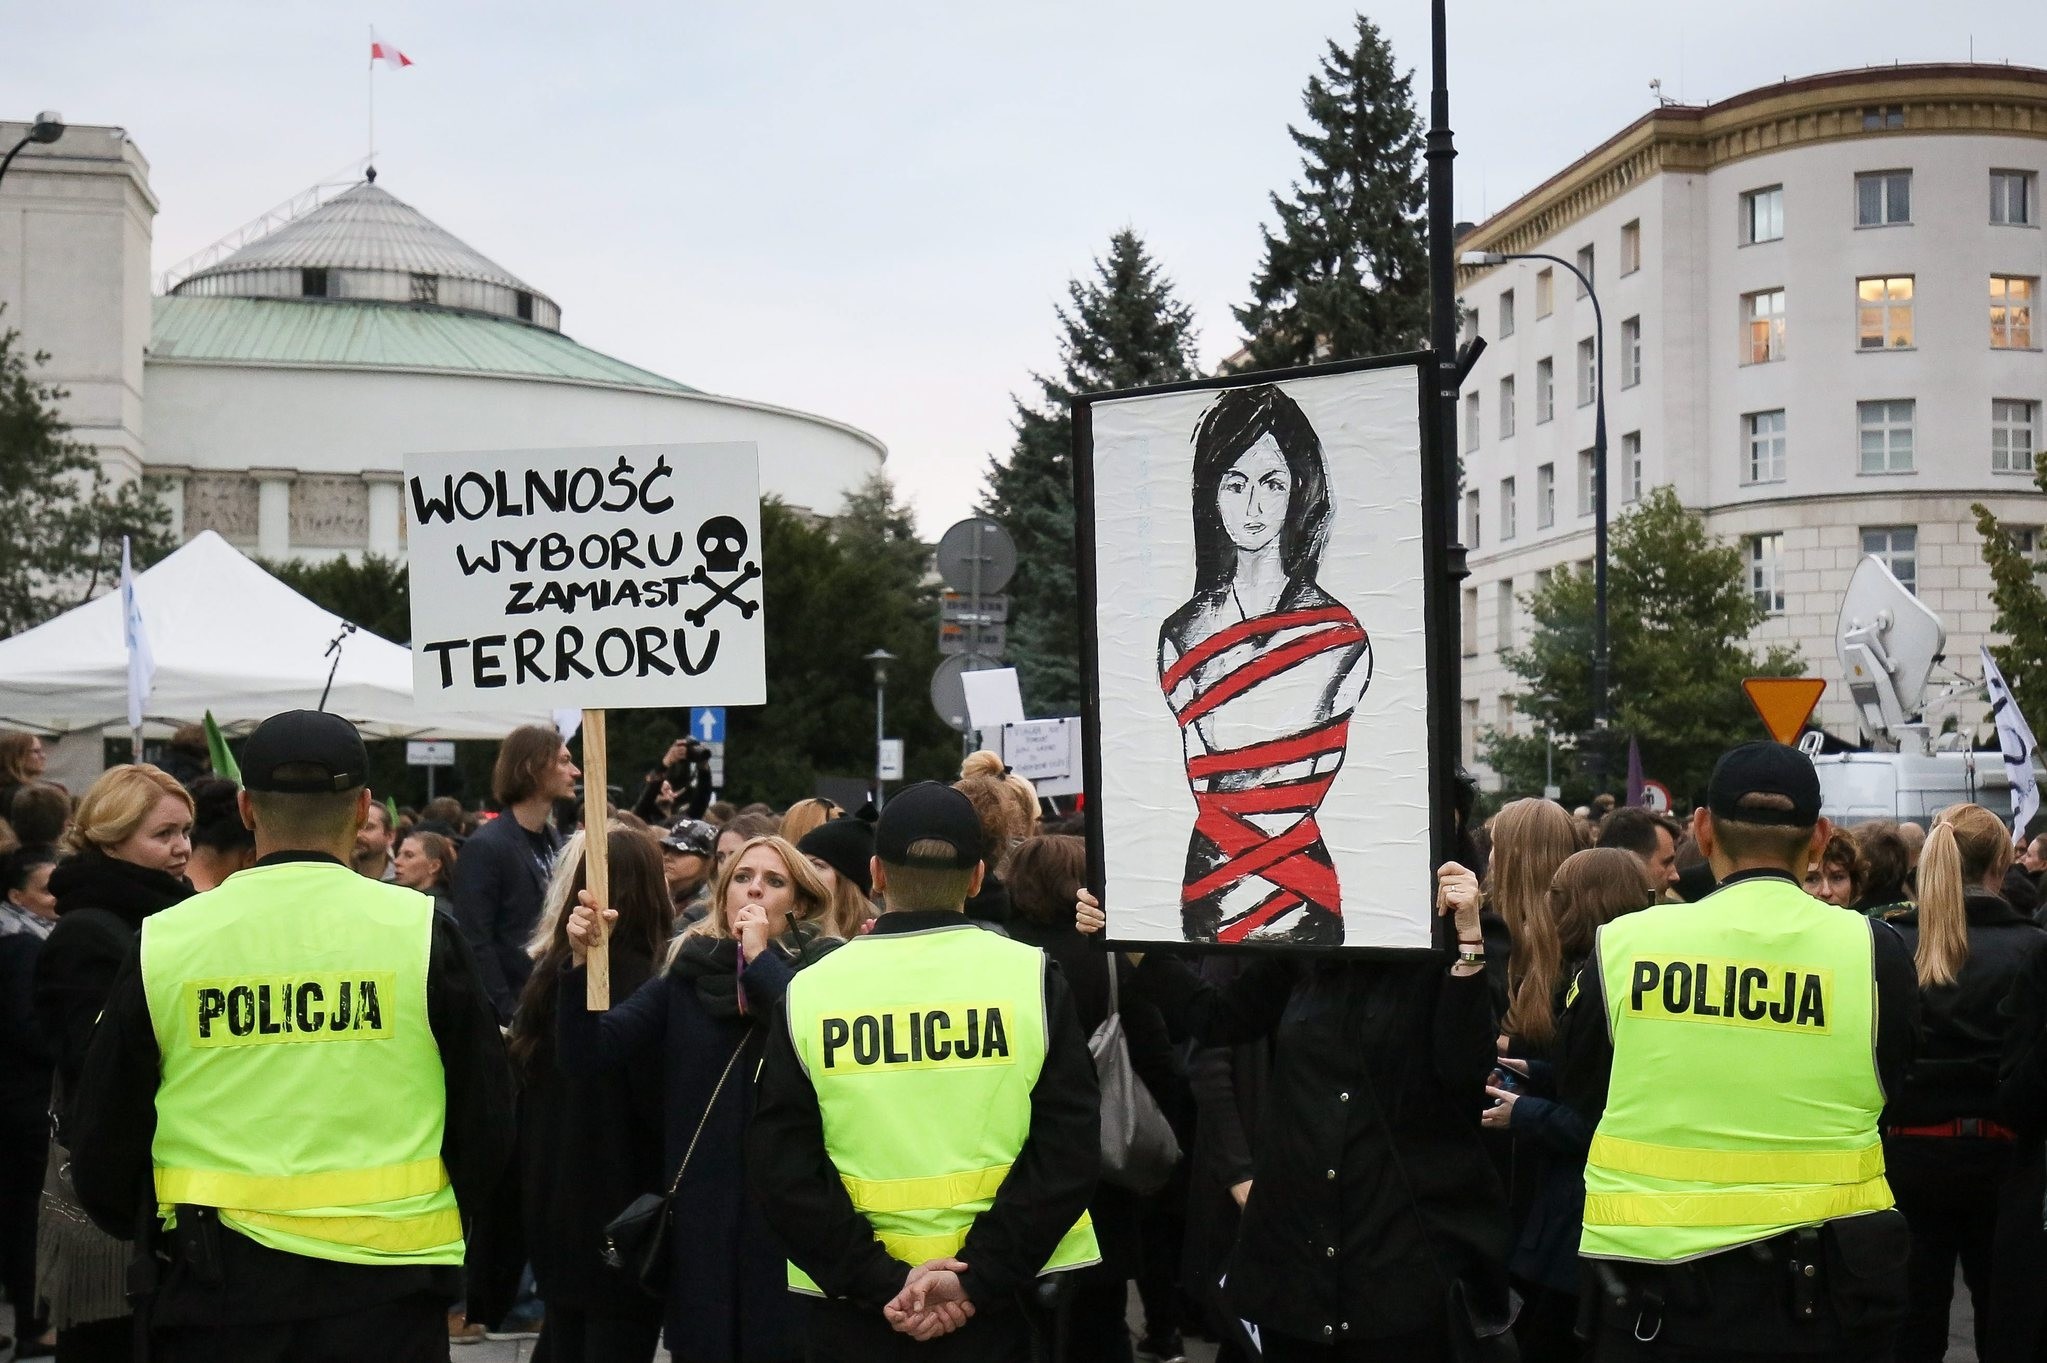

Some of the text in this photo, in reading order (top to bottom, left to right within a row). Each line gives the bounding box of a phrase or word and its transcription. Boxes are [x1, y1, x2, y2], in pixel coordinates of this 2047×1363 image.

[410, 454, 674, 525] WOLNOŚĆ
[456, 528, 683, 576] WYBORU
[505, 576, 690, 615] ZAMIAST
[423, 625, 720, 689] TERRORU
[197, 981, 382, 1038] POLICJA
[1631, 960, 1825, 1027] POLICJA
[823, 1007, 1009, 1069] POLICJA
